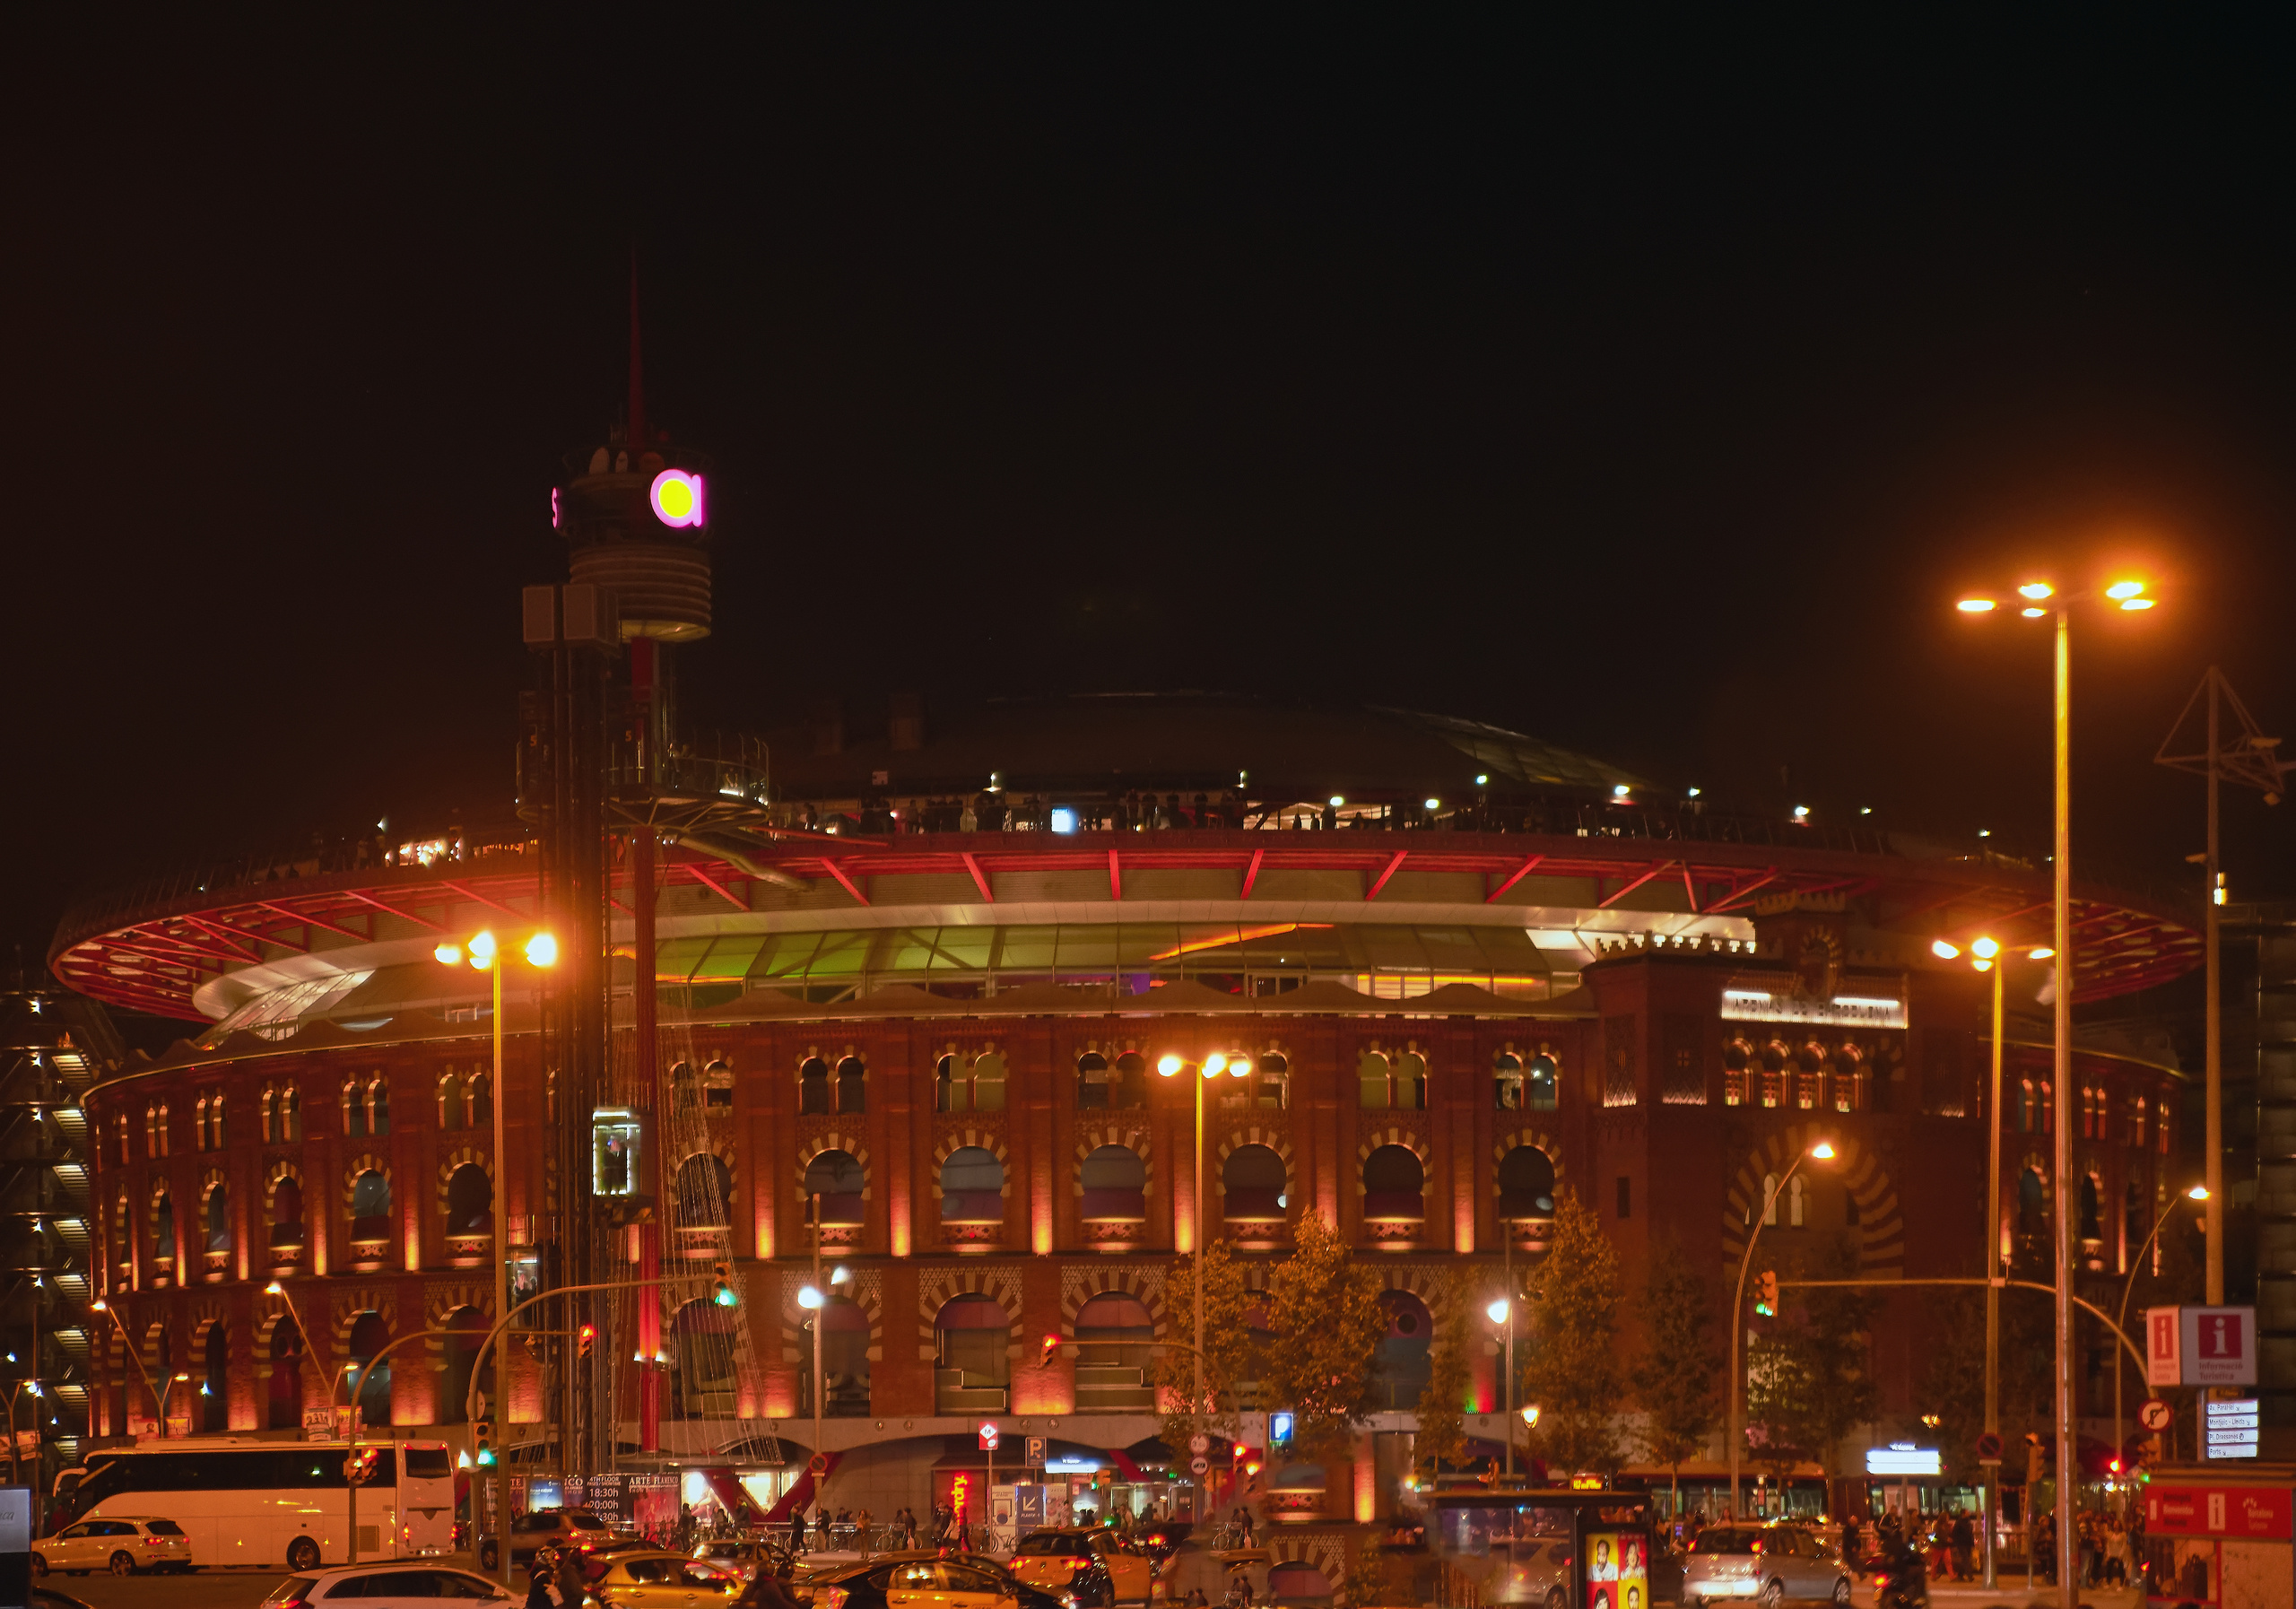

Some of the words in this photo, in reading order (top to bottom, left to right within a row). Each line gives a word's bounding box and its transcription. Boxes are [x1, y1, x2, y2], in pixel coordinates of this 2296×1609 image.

[1029, 1439, 1043, 1457] P
[629, 1476, 651, 1485] ARTE
[589, 1488, 619, 1498] 18:30h
